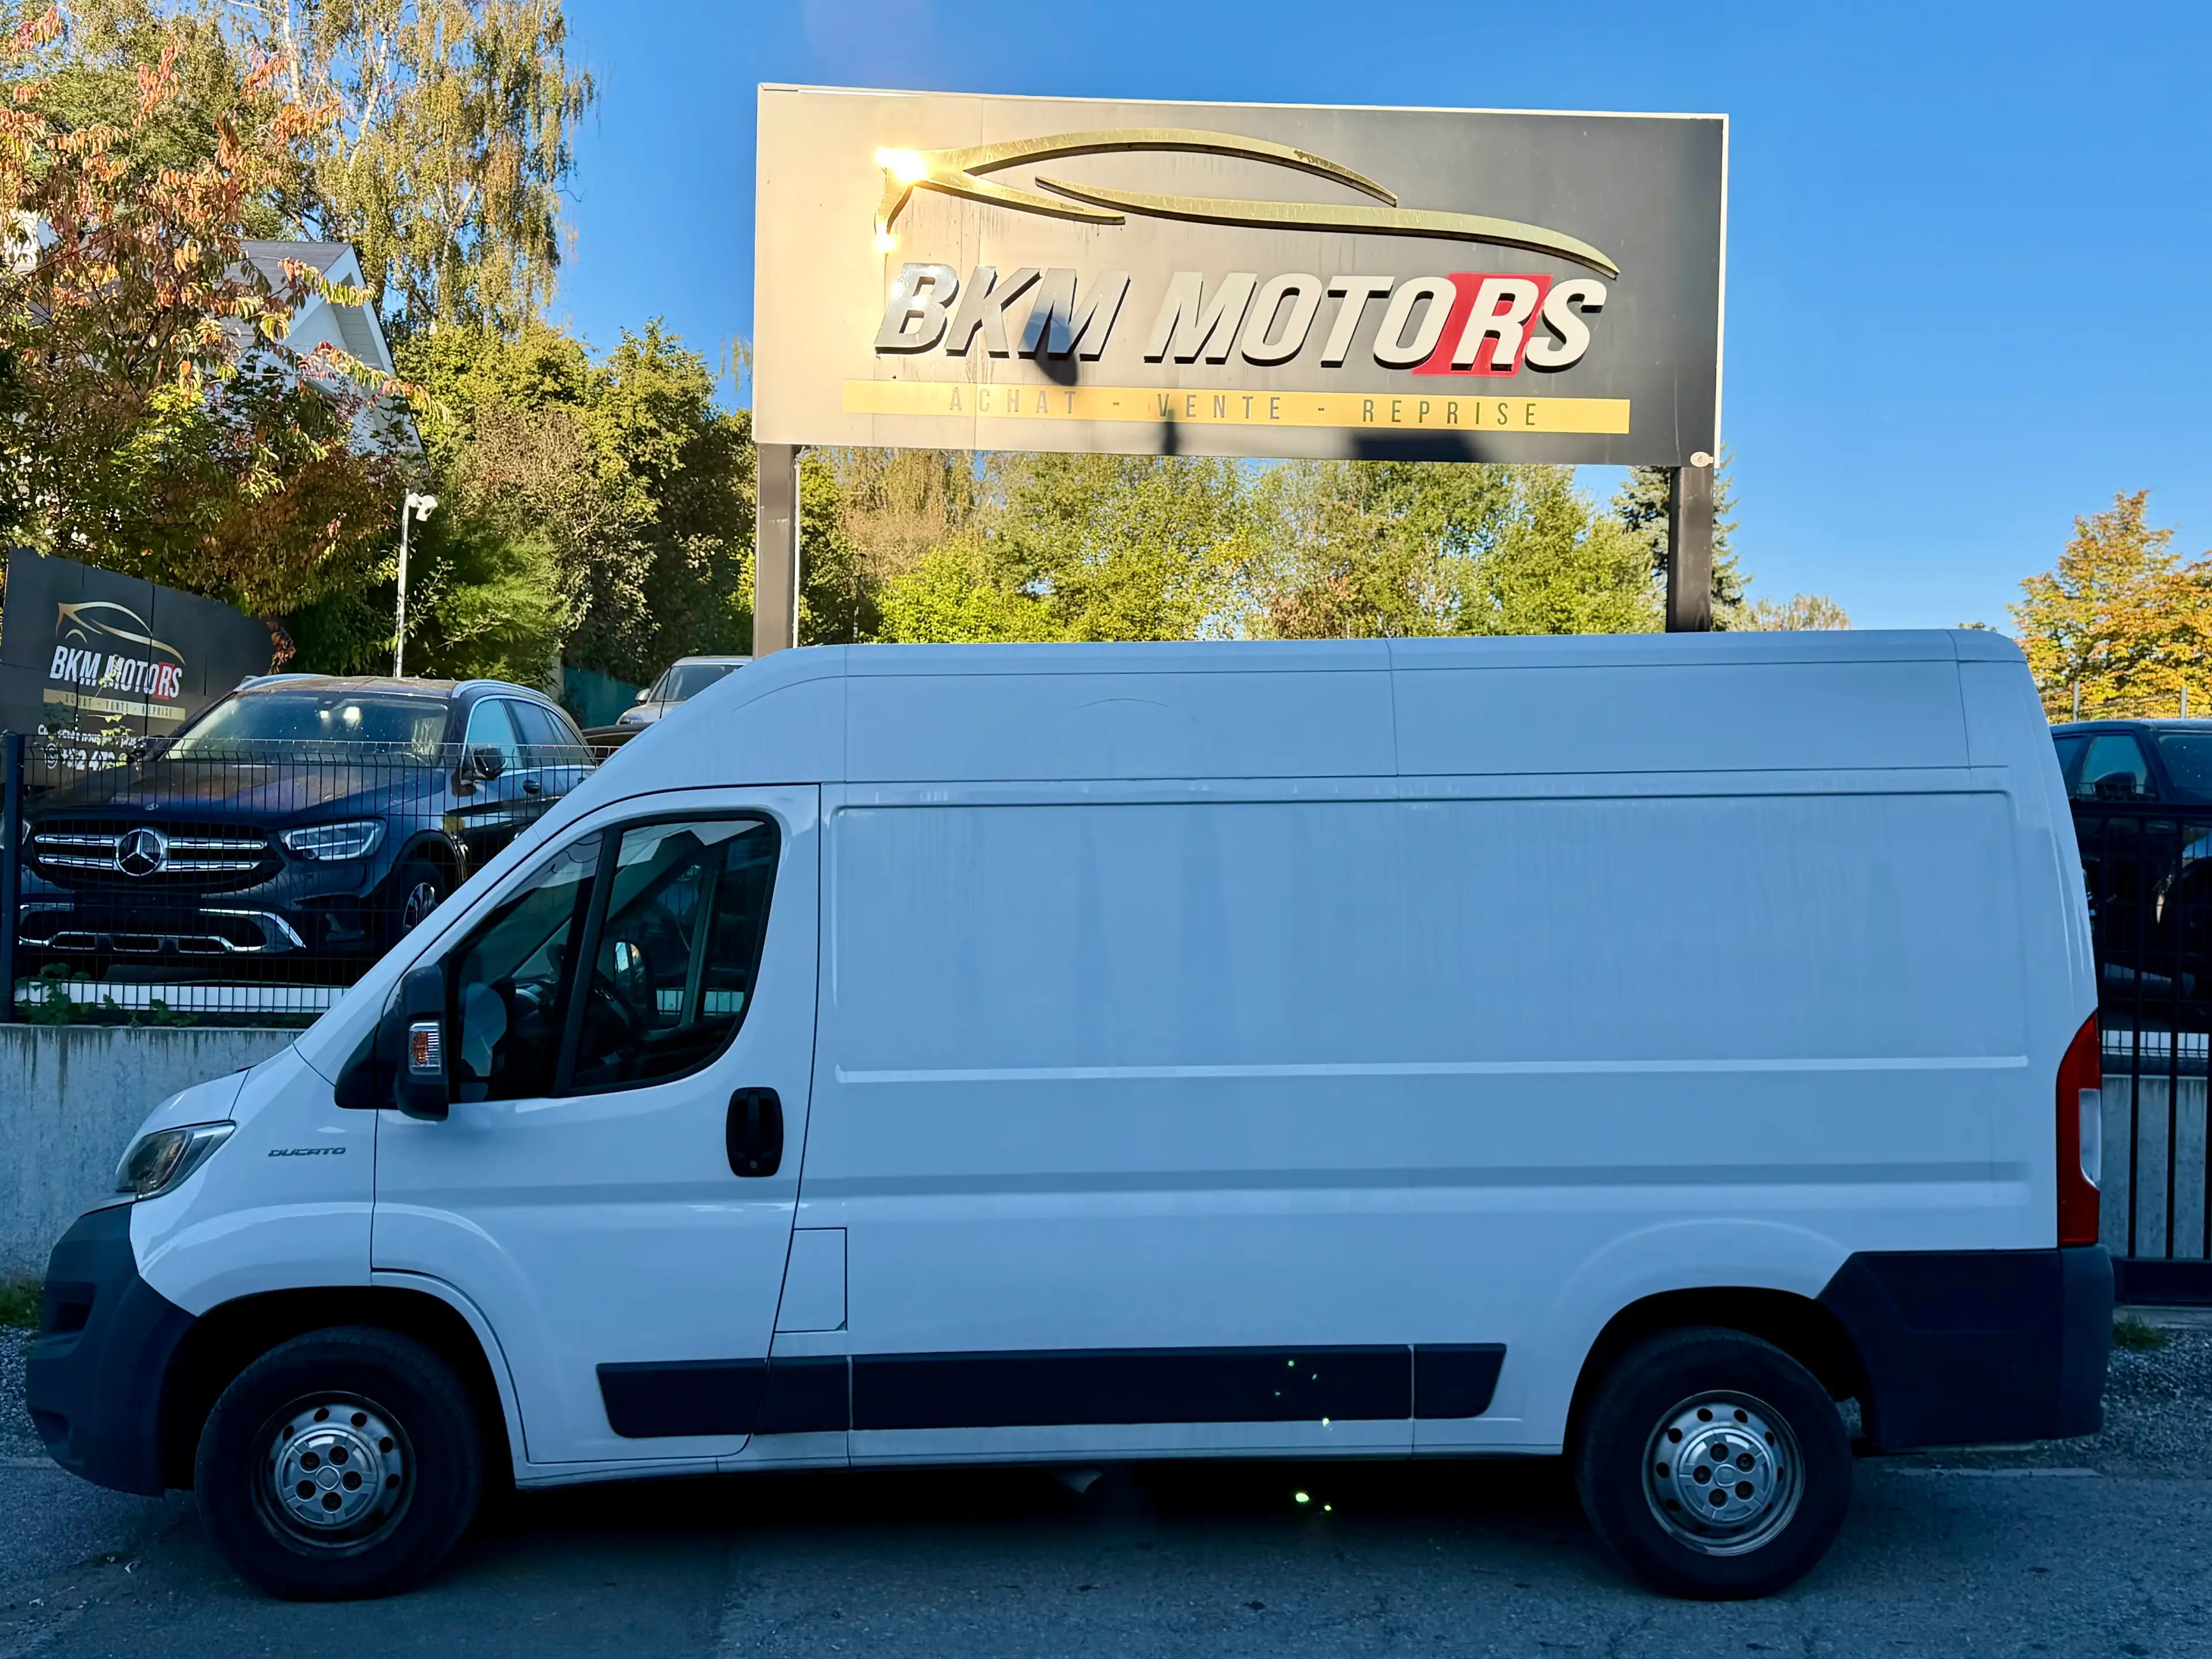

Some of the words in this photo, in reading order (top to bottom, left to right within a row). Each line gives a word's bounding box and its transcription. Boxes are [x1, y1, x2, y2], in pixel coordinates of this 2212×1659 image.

[874, 262, 1131, 363] BKM
[1143, 271, 1608, 374] MOTORS
[949, 387, 1076, 414] ACHAT
[1157, 393, 1281, 419] VENTE
[1363, 399, 1537, 426] REPRISE
[50, 645, 102, 687] BKM
[103, 654, 183, 698] MOTORS
[105, 699, 128, 713] VENTE
[142, 704, 173, 717] REPRISE
[268, 1147, 346, 1157] DUCATO
